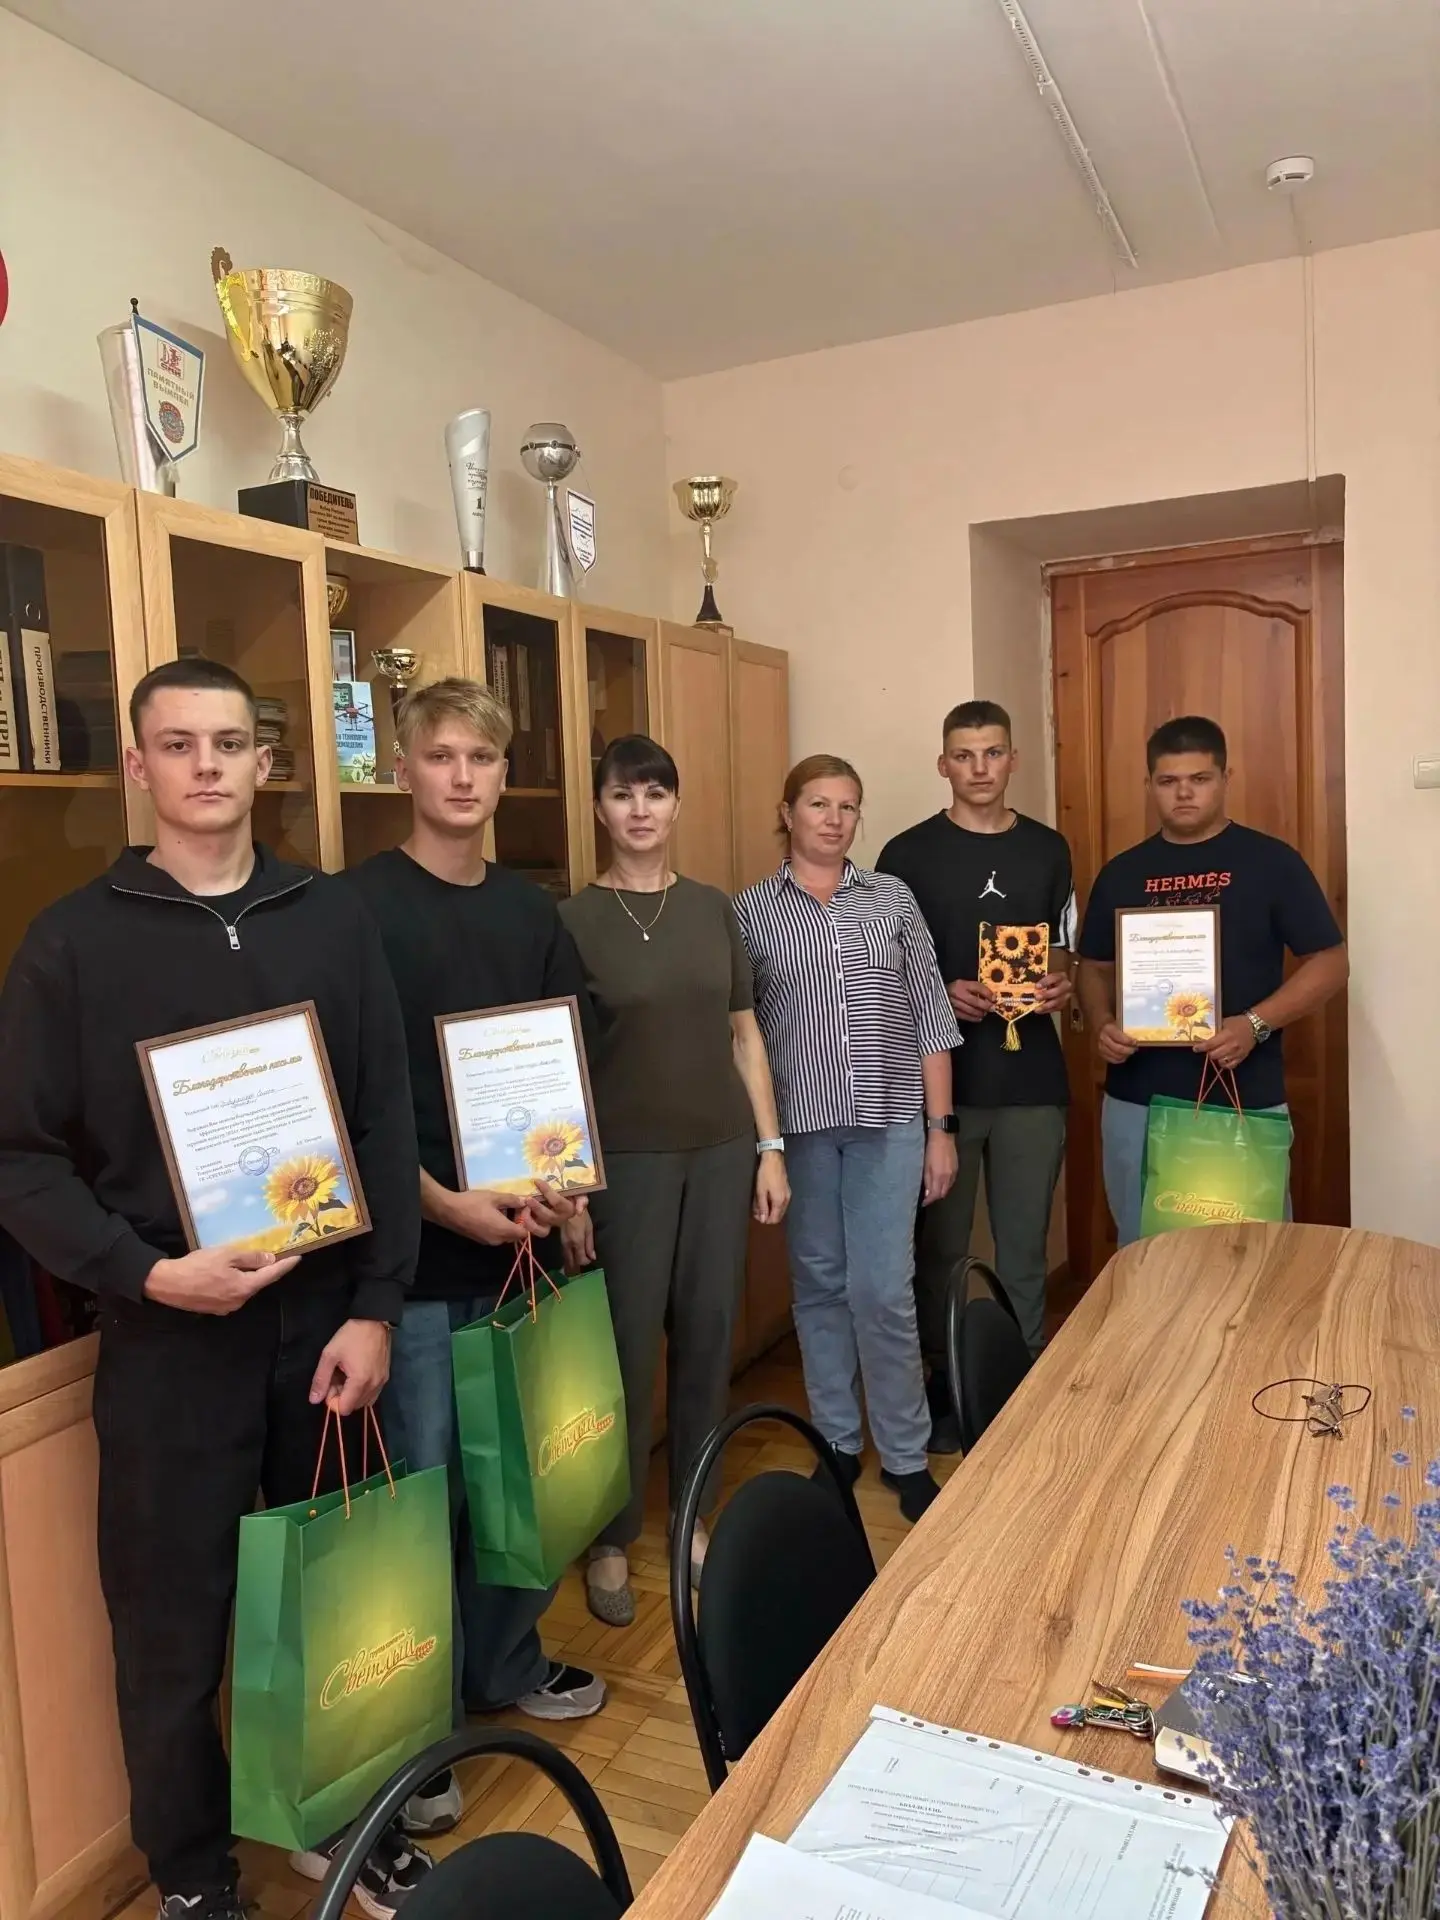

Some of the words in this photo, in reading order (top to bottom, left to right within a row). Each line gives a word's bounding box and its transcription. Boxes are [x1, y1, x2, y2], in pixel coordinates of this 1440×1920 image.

[147, 367, 195, 401] ПАМЯТНЫЙ
[153, 380, 189, 407] ВЫМПЕЛ
[309, 487, 354, 510] ПОБЕДИТЕЛЬ
[34, 646, 52, 764] ПРОИЗВОДСТВЕННИКИ
[172, 1062, 268, 1097] Благодарственное
[268, 1054, 303, 1071] письмо
[538, 1408, 597, 1476] Светлый
[320, 1627, 416, 1710] Светлый
